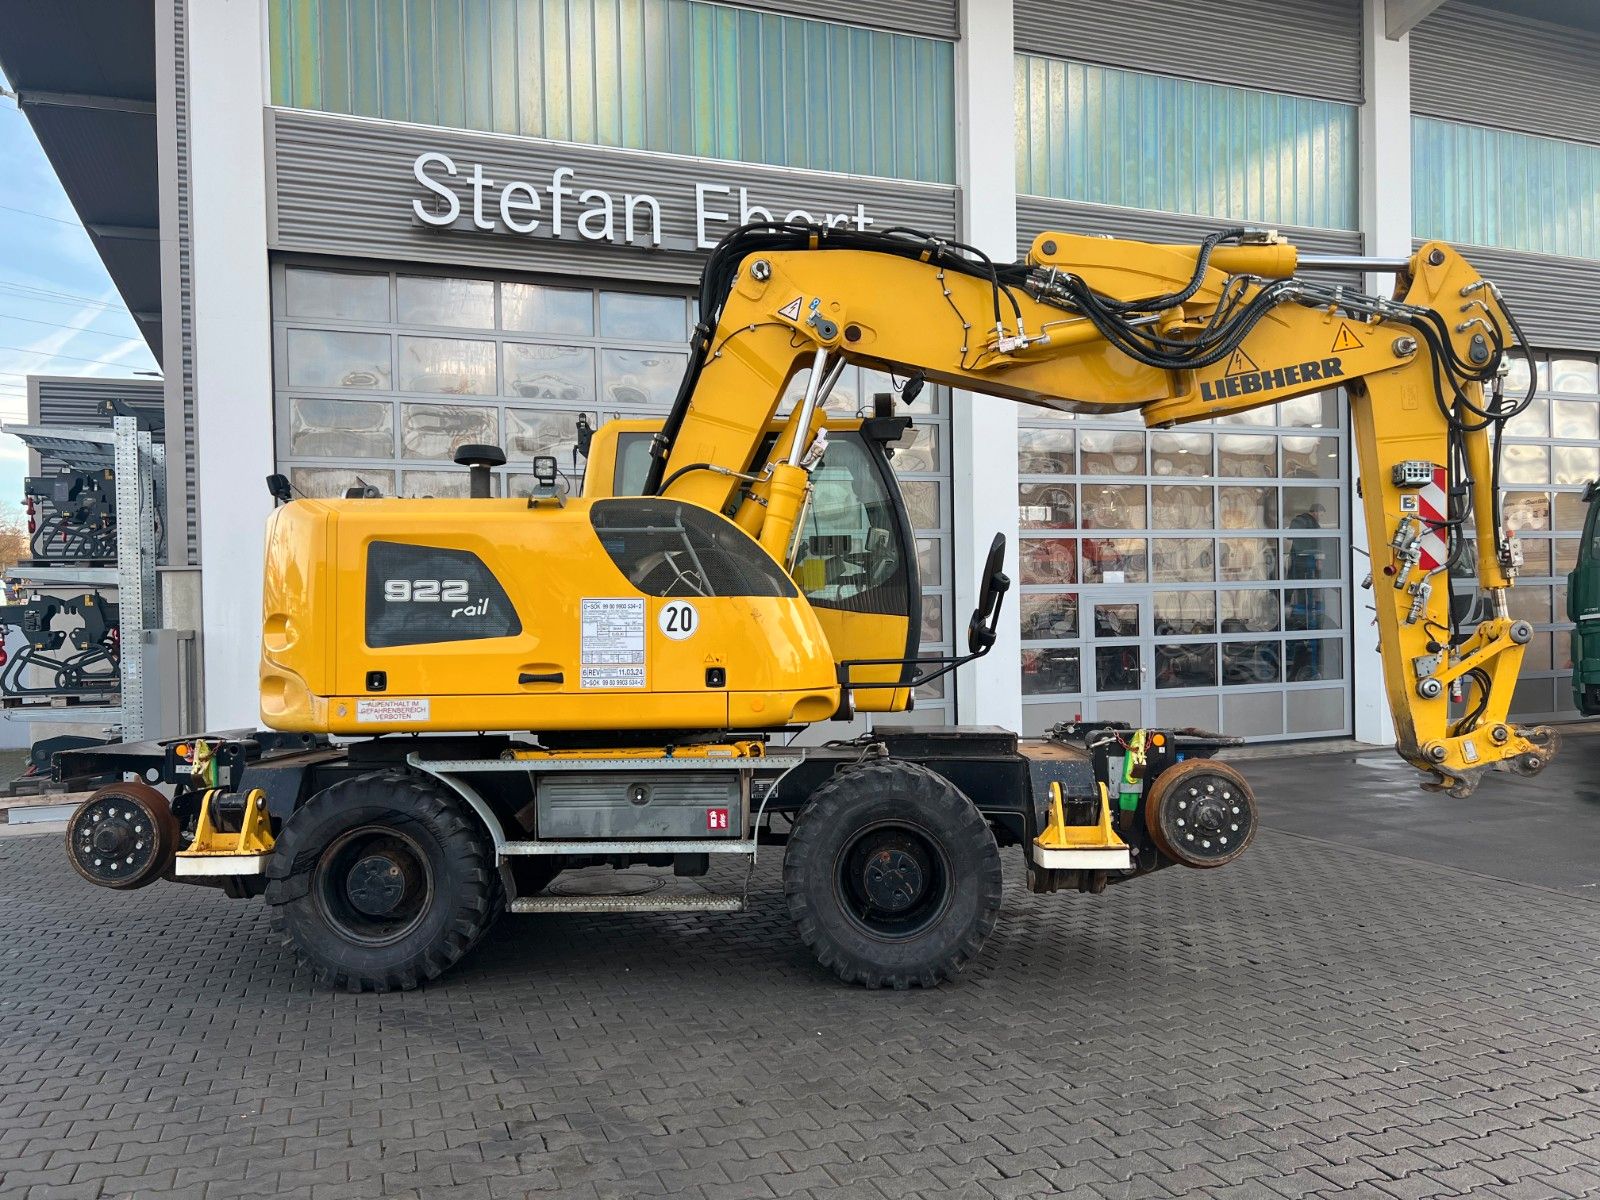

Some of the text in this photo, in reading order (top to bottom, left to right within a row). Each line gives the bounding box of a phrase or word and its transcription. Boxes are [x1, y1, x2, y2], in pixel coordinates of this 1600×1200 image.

[412, 152, 661, 246] Stefan
[1200, 357, 1344, 402] LIEBHERR
[384, 579, 469, 602] 922
[451, 597, 490, 618] rail
[666, 606, 692, 632] 20
[618, 668, 643, 676] 11.03.24
